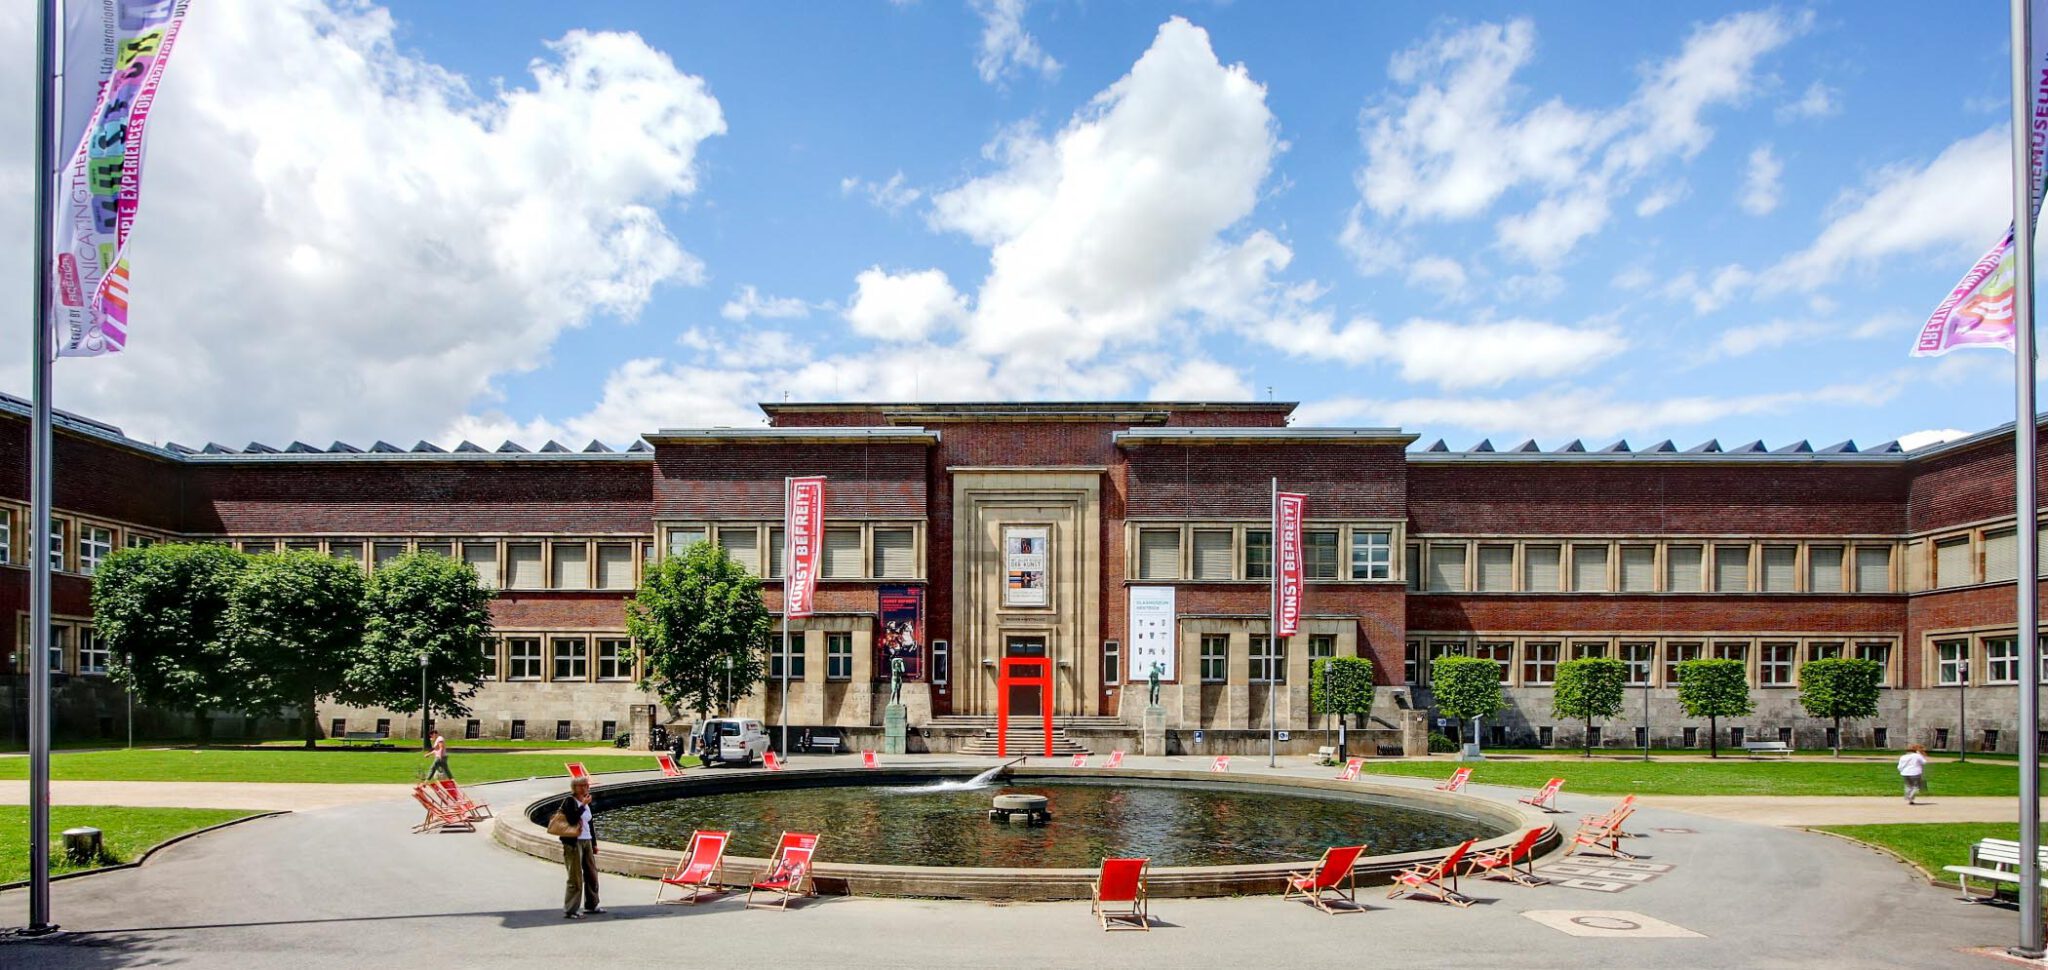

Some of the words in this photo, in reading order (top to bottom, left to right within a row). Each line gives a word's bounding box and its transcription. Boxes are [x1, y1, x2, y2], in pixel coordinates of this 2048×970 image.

[120, 119, 145, 199] EXPERIENCES
[133, 93, 153, 115] FOR
[68, 319, 82, 341] EVENT
[69, 309, 81, 318] BY
[795, 486, 810, 556] BEFREIT!
[1283, 501, 1296, 571] BEFREIT!
[791, 560, 808, 612] KUNST
[1283, 576, 1297, 629] KUNST
